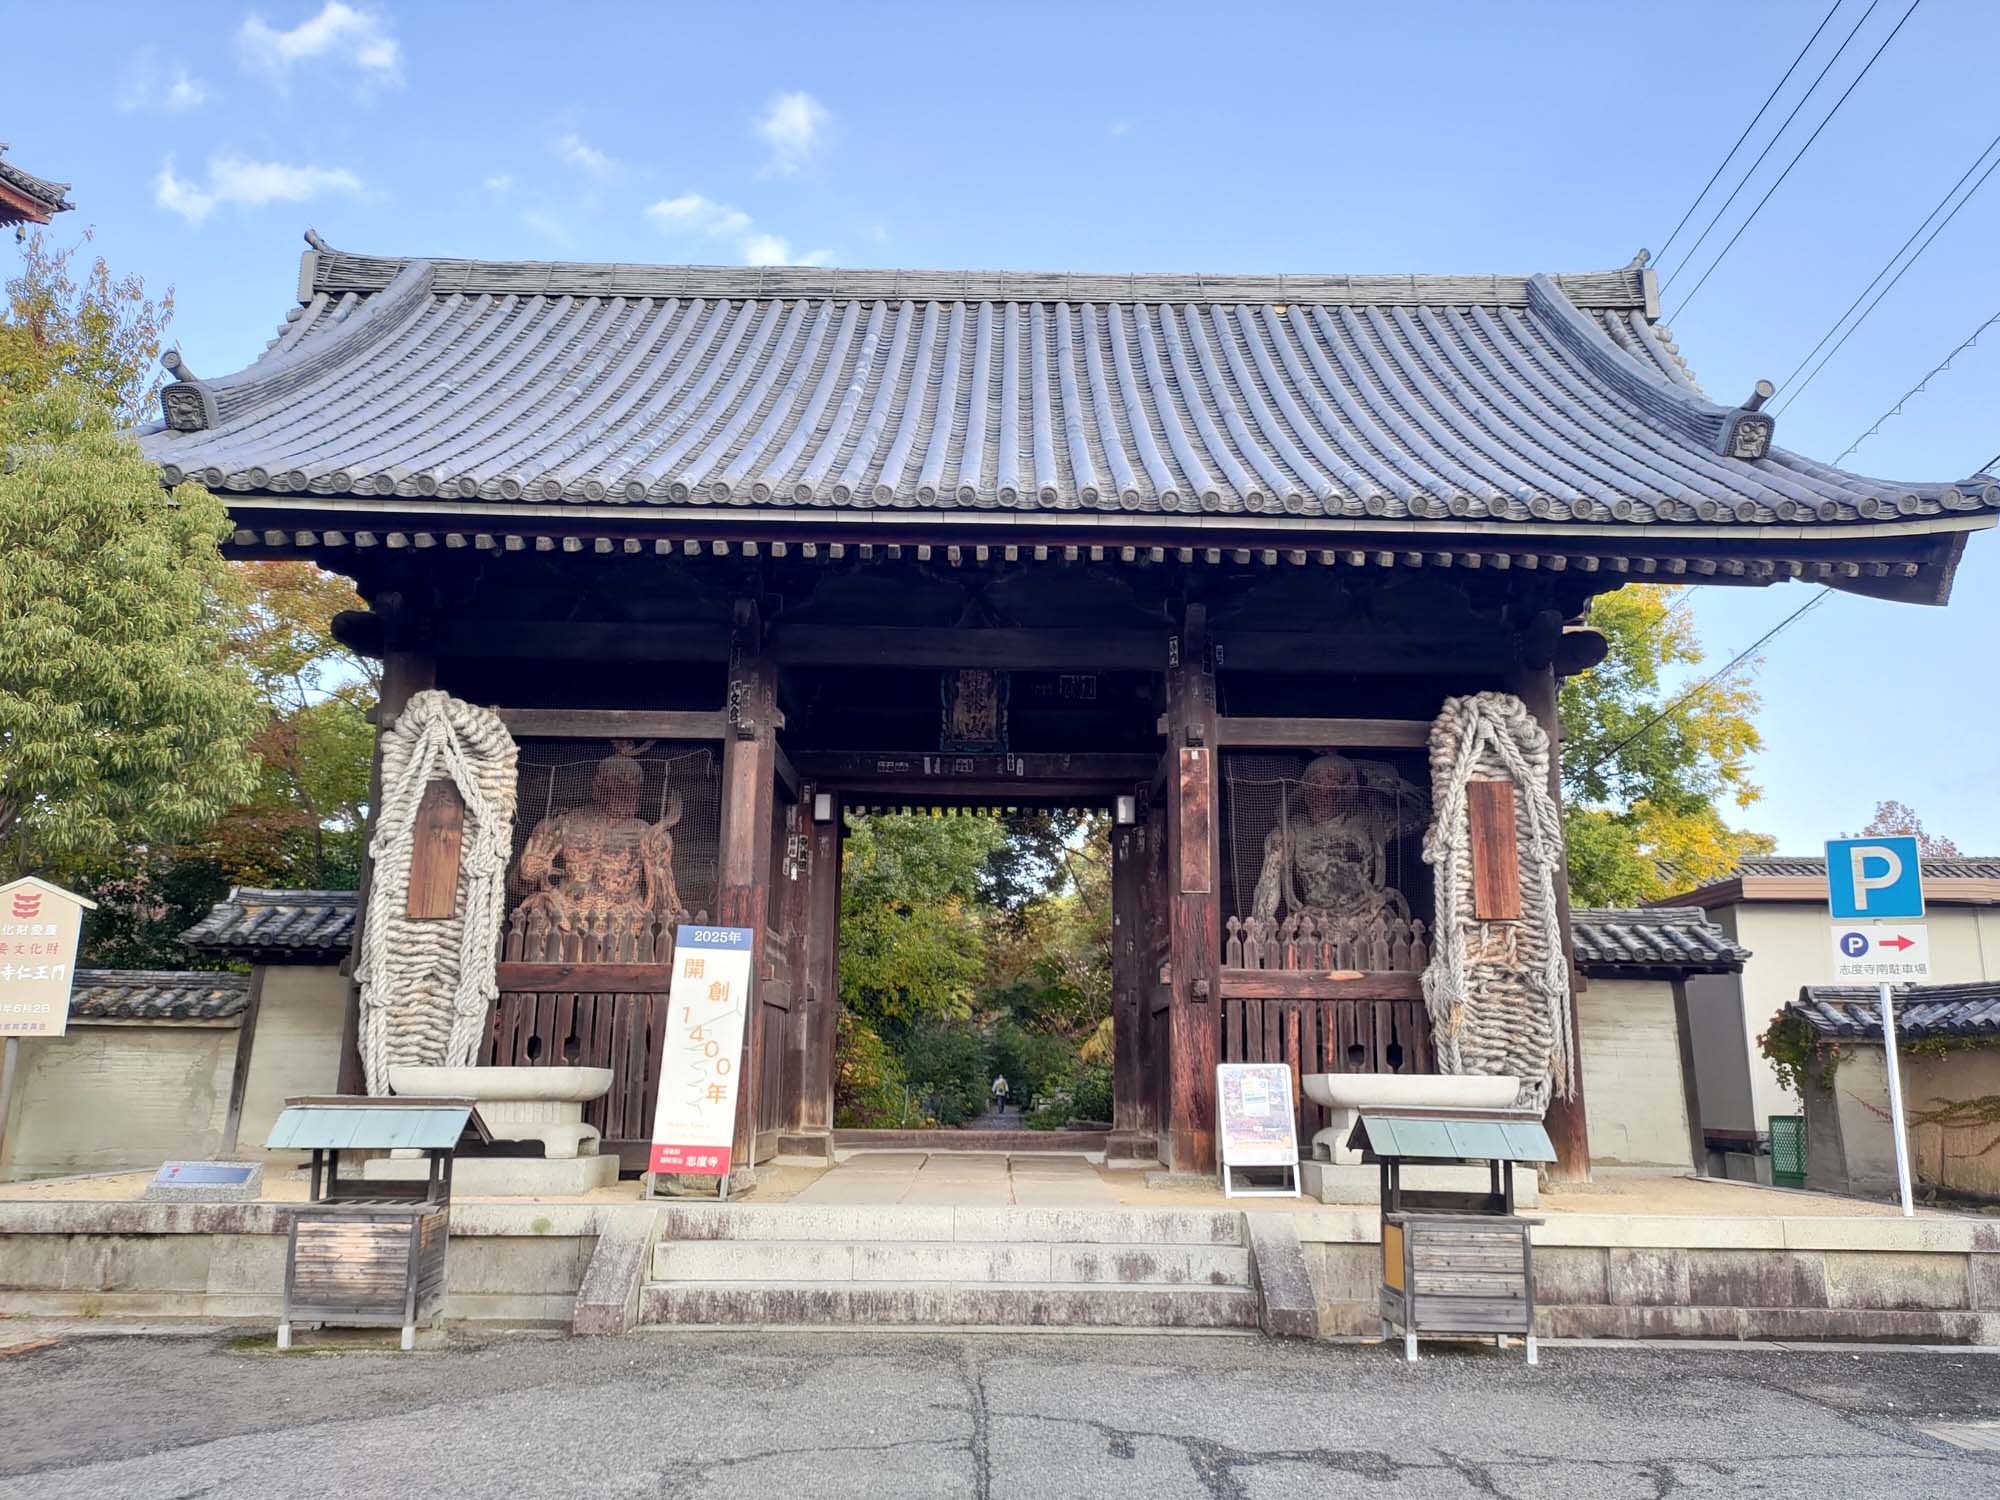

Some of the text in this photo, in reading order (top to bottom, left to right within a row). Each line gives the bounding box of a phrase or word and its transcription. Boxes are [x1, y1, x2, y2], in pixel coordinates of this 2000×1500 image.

[1850, 846, 1902, 911] P
[694, 930, 742, 944] 2025年
[1848, 937, 1864, 954] P
[0, 963, 65, 982] 寺仁王門
[1839, 963, 1928, 976] 志度寺南駐車場
[685, 1155, 718, 1168] 志度寺
